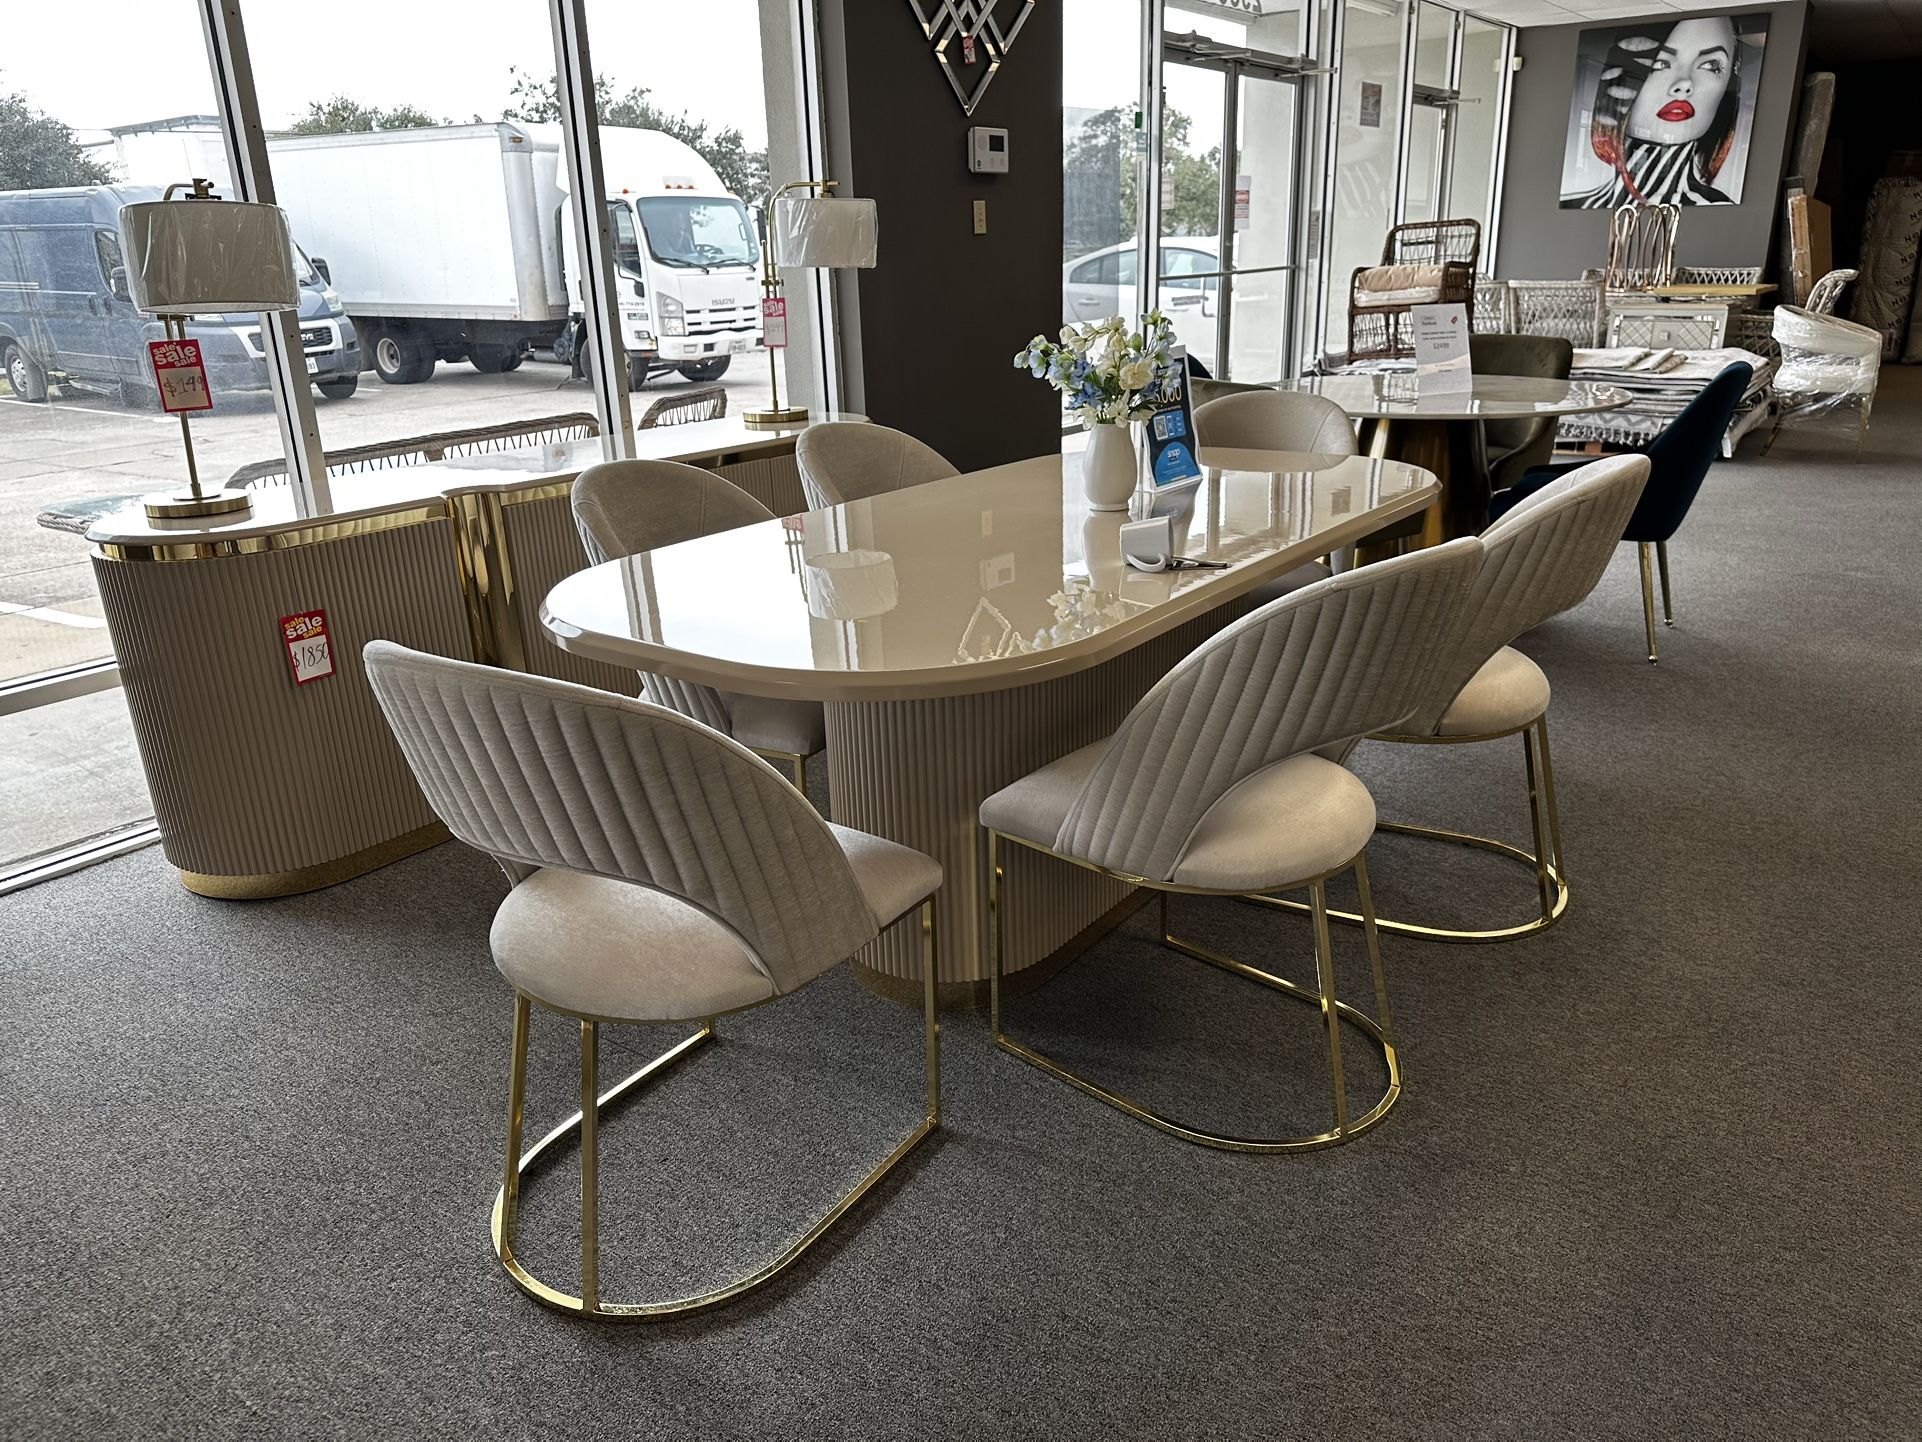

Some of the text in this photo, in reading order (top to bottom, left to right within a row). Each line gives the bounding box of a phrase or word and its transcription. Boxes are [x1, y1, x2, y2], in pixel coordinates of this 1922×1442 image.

[711, 298, 735, 306] ISUZU
[763, 302, 784, 315] sale
[153, 344, 175, 355] sale
[154, 345, 197, 366] sale
[174, 356, 197, 367] sale
[164, 375, 205, 397] $149
[1167, 448, 1181, 459] snap
[285, 616, 305, 630] sale
[285, 616, 323, 639] sale
[302, 626, 323, 639] sale
[293, 641, 329, 672] $1850
